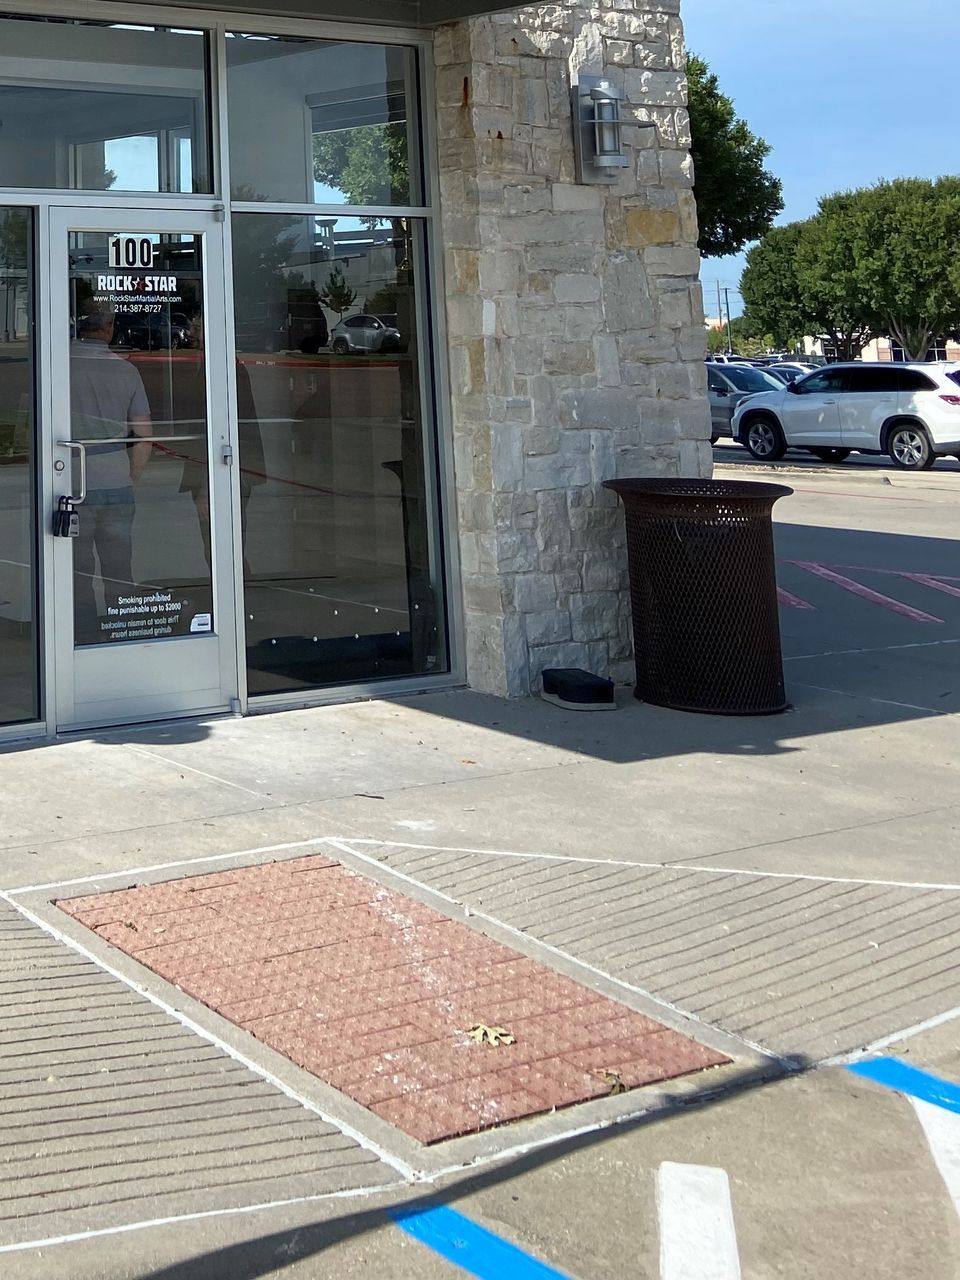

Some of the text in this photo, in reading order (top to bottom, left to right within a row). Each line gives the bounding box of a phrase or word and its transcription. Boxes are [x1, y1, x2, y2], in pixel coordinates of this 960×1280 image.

[111, 237, 152, 267] 100
[97, 275, 177, 291] ROCK STAR
[93, 294, 182, 303] www.RockStarMartialArts.com
[114, 305, 162, 313] 214-387-8727
[118, 592, 171, 605] Smoking prohibited
[107, 606, 119, 615] fine
[119, 605, 149, 615] punishable
[150, 605, 158, 613] up
